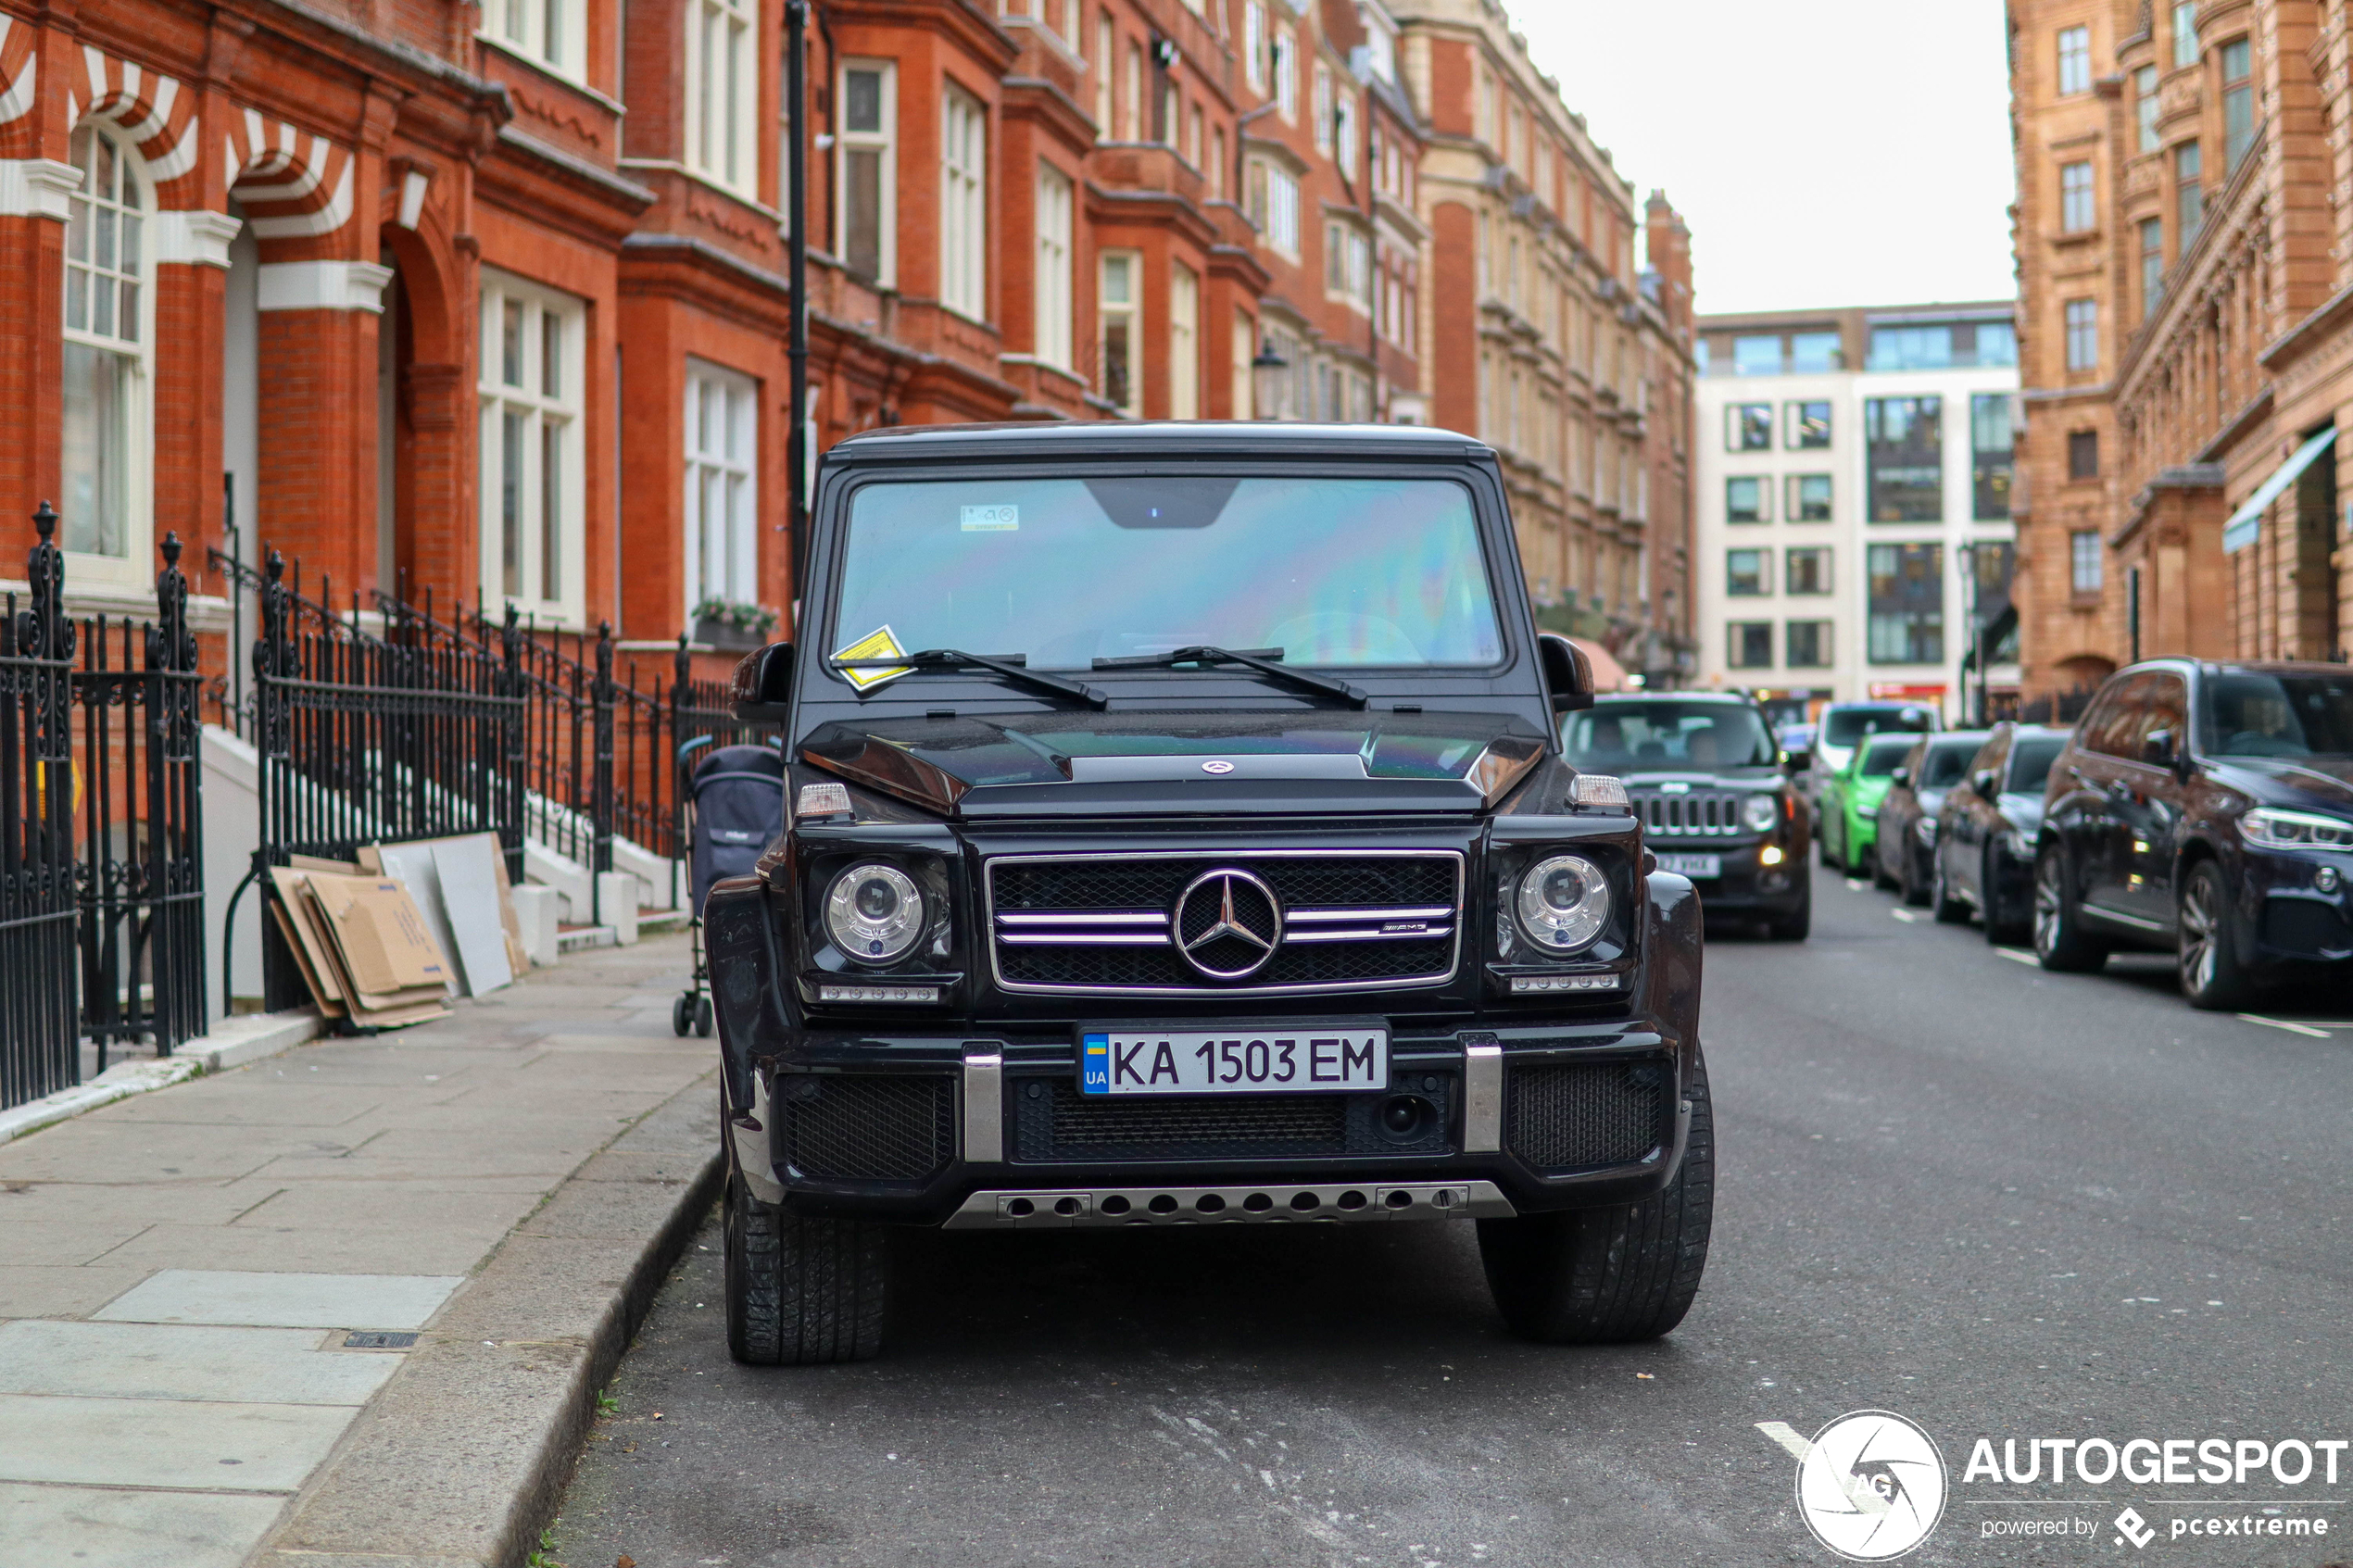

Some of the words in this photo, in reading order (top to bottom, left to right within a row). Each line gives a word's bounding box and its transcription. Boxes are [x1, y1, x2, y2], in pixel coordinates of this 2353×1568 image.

[1114, 1040, 1179, 1085] KA
[1195, 1039, 1296, 1084] 1503
[1310, 1037, 1375, 1082] EM
[1087, 1072, 1106, 1085] UA
